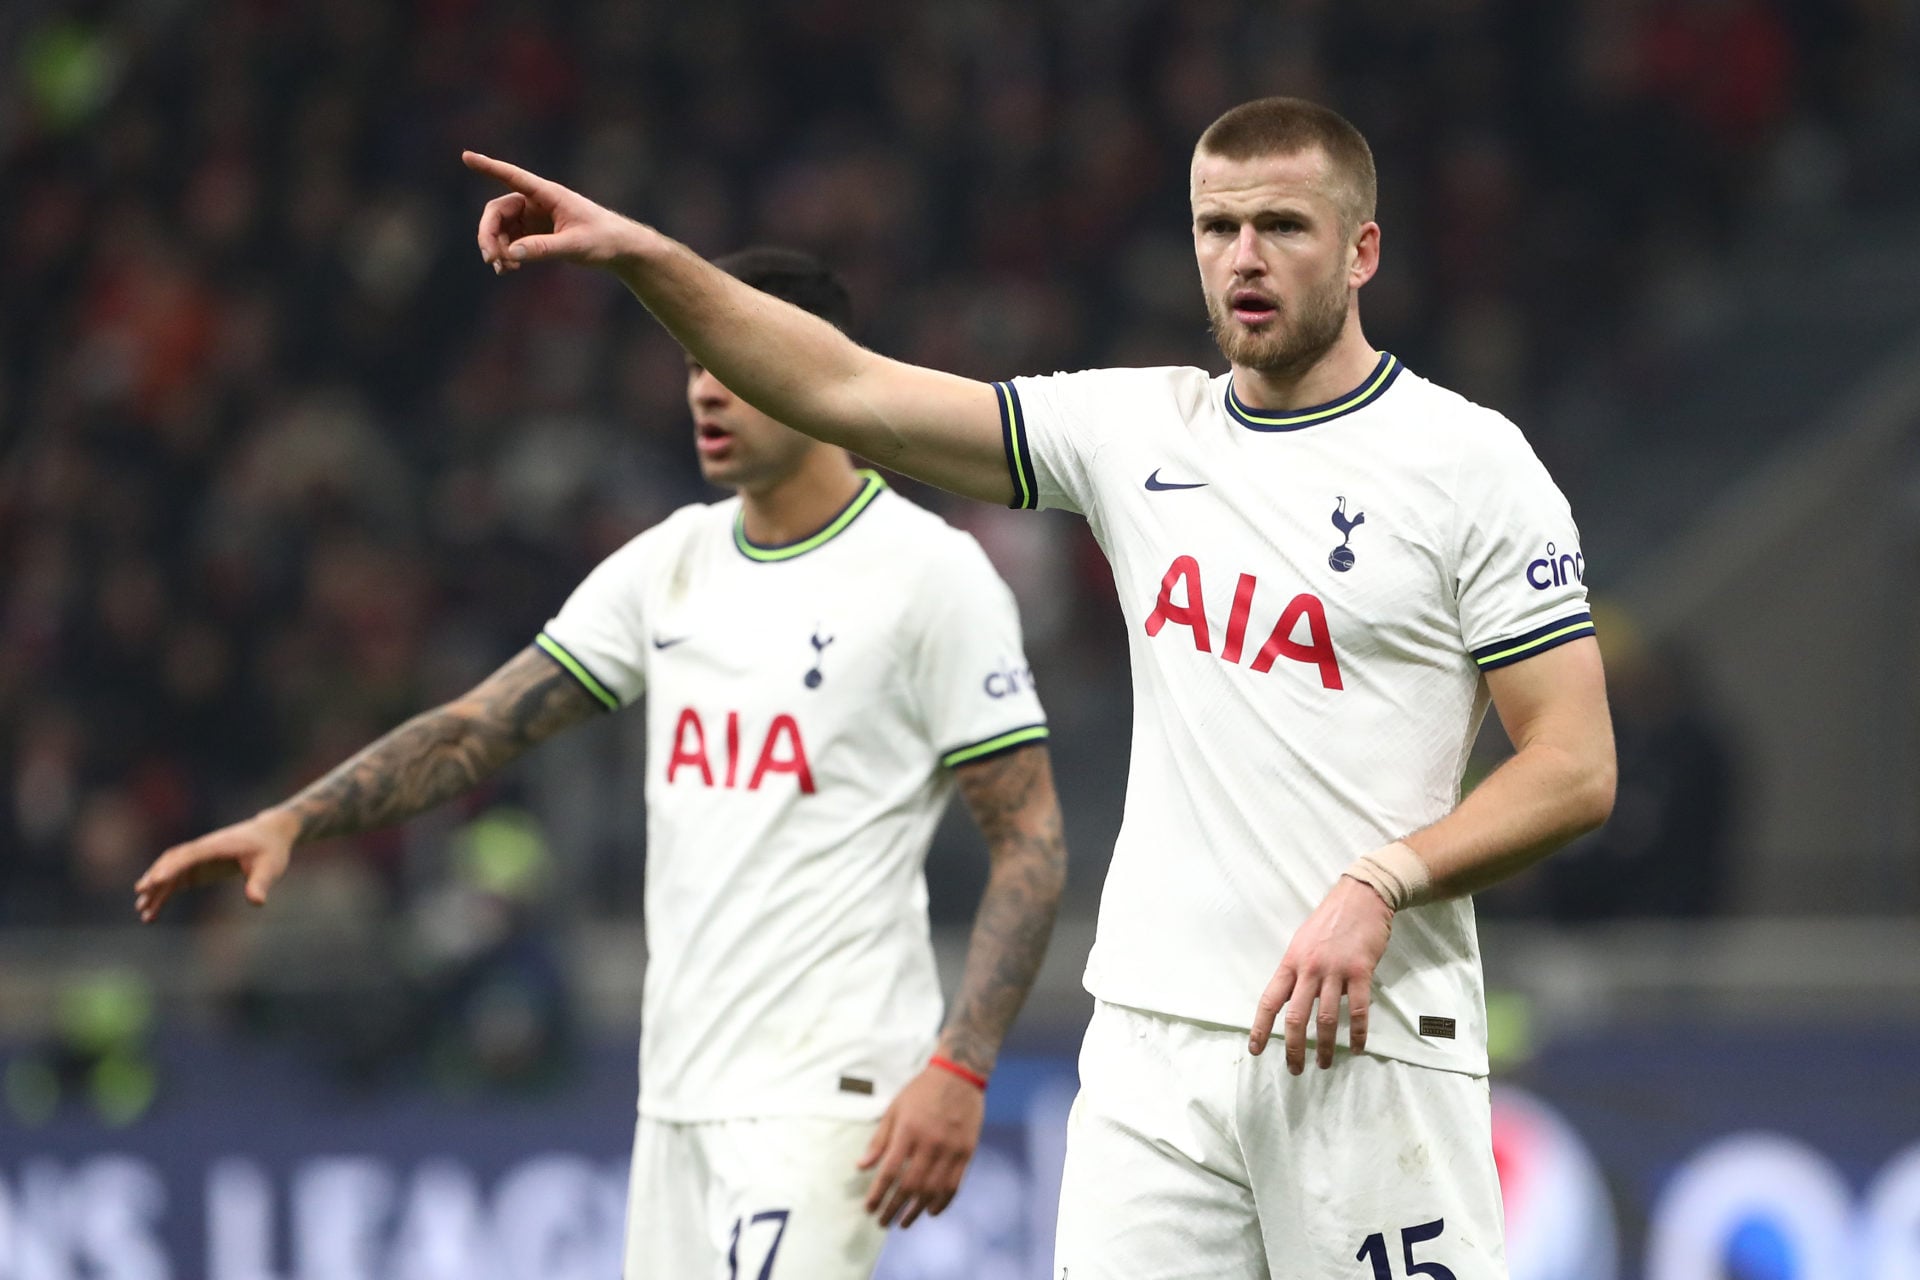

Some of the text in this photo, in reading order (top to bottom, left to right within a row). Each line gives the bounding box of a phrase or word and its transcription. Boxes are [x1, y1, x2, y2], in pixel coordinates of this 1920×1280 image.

[1144, 554, 1344, 691] AIA
[666, 706, 817, 795] AIA
[728, 1209, 791, 1280] 17
[1356, 1216, 1457, 1280] 15
